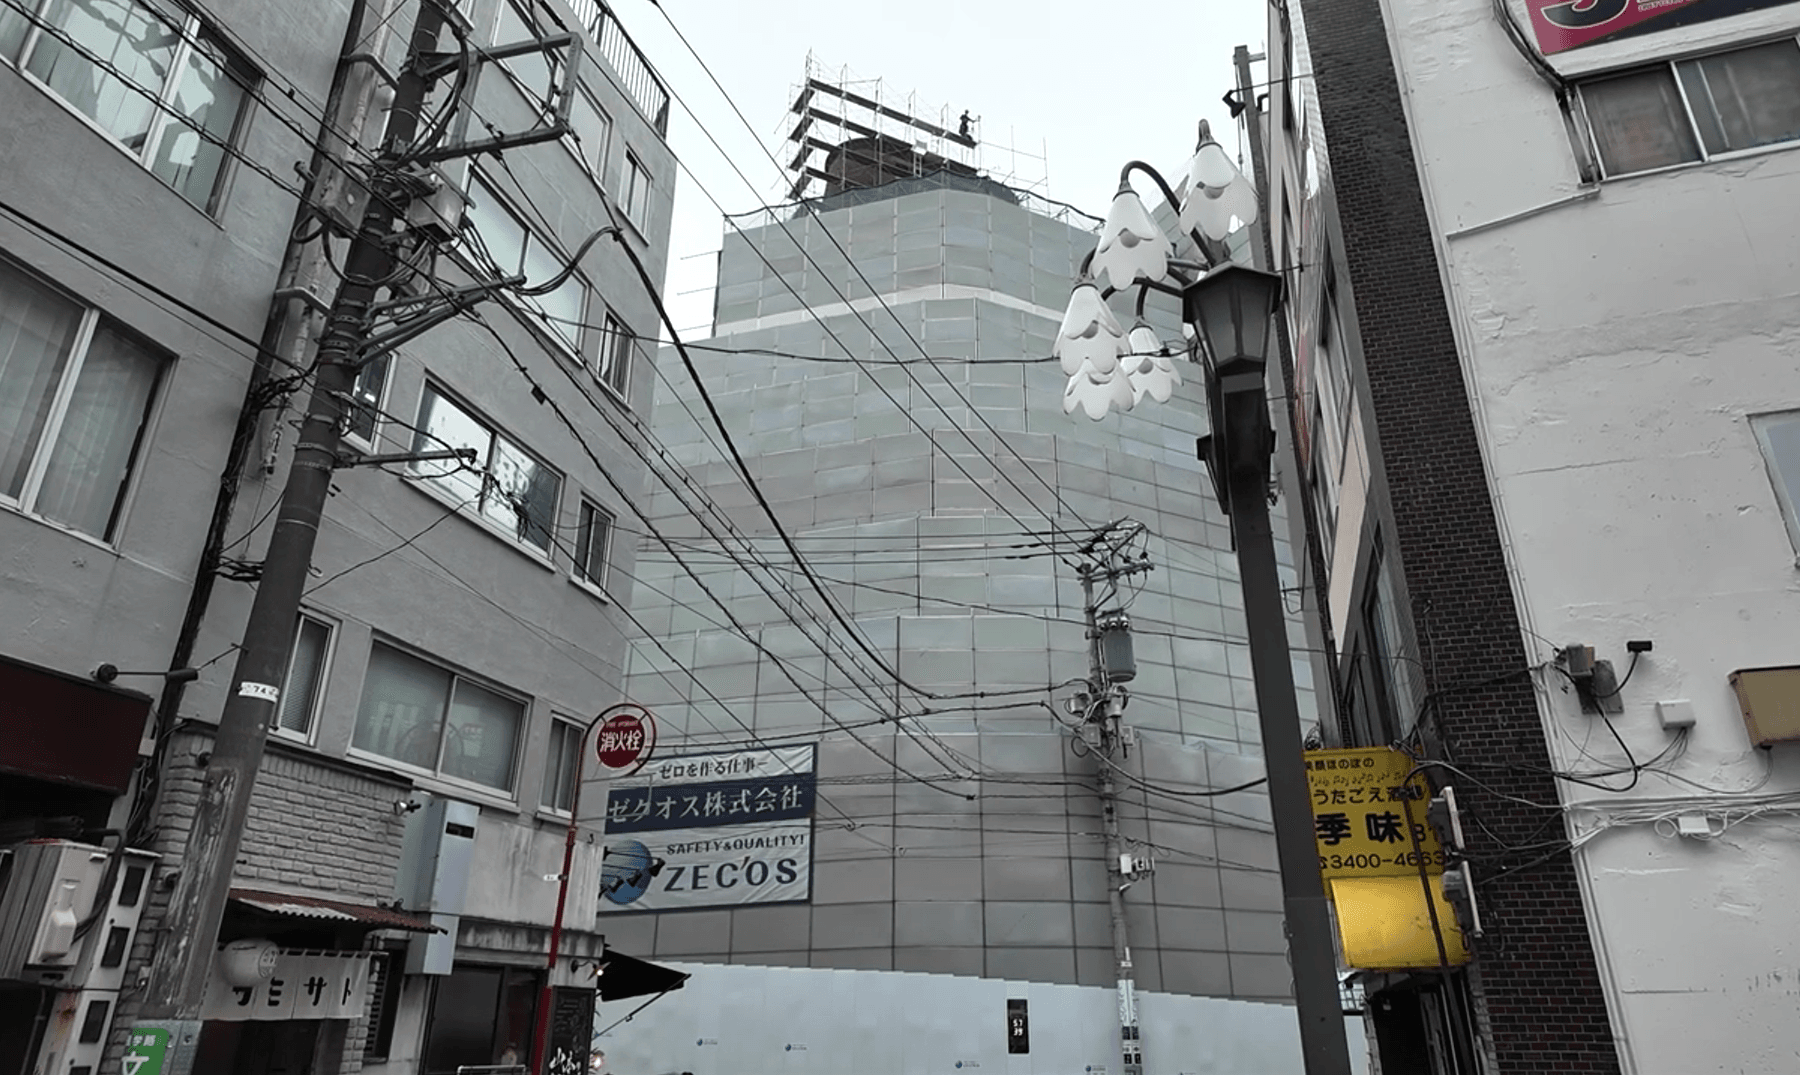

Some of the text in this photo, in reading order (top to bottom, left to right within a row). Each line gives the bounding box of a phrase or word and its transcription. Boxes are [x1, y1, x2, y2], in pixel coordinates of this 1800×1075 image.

[600, 729, 642, 752] 消火栓
[608, 784, 803, 824] ゼクオス株式会社
[666, 834, 804, 855] SAFETY&QUALITY!
[663, 856, 798, 892] ZEC'OS
